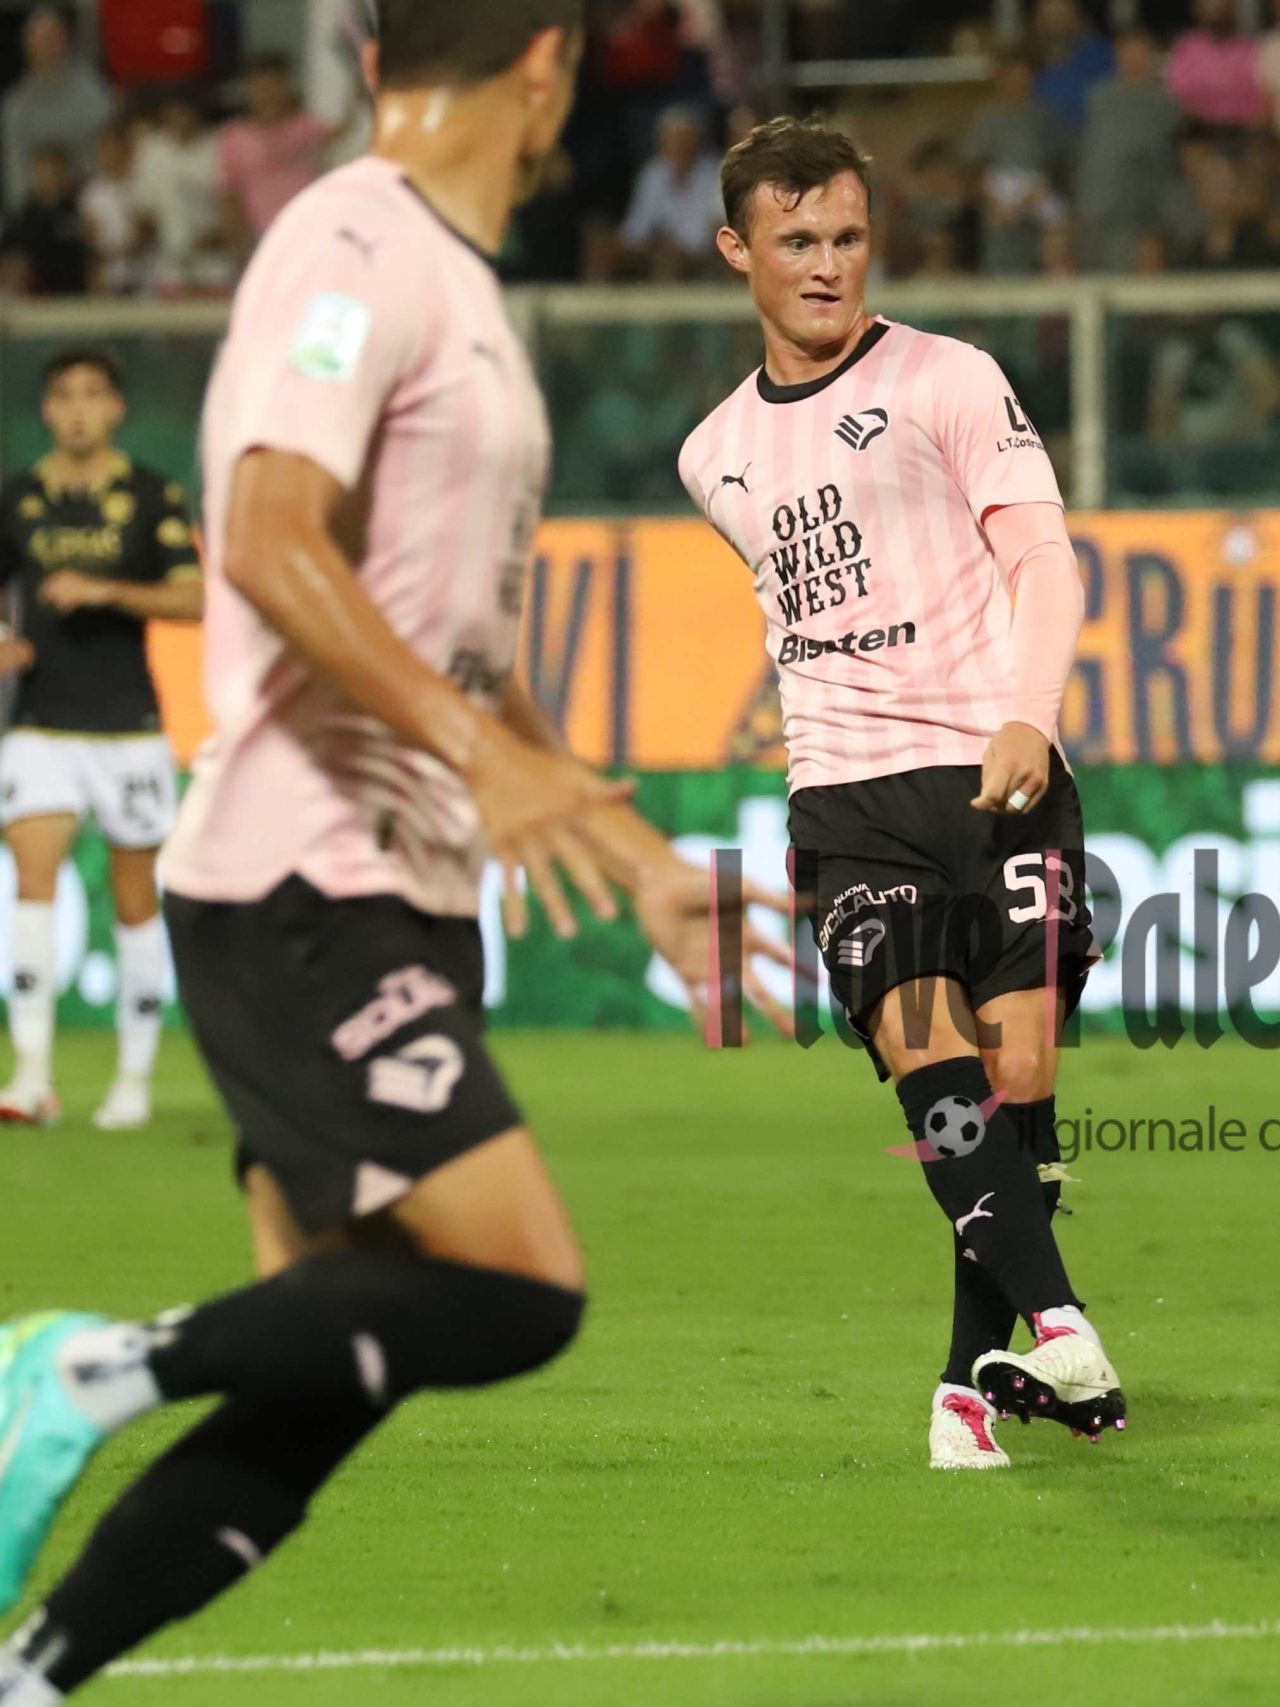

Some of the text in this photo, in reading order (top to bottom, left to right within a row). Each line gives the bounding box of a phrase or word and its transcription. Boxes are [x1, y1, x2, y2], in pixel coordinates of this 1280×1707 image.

[772, 483, 842, 541] OLD
[770, 520, 862, 586] WILD
[777, 558, 872, 627] WEST
[819, 884, 917, 953] SICILAUTO
[833, 883, 870, 908] NUOVA
[1003, 852, 1078, 924] 53
